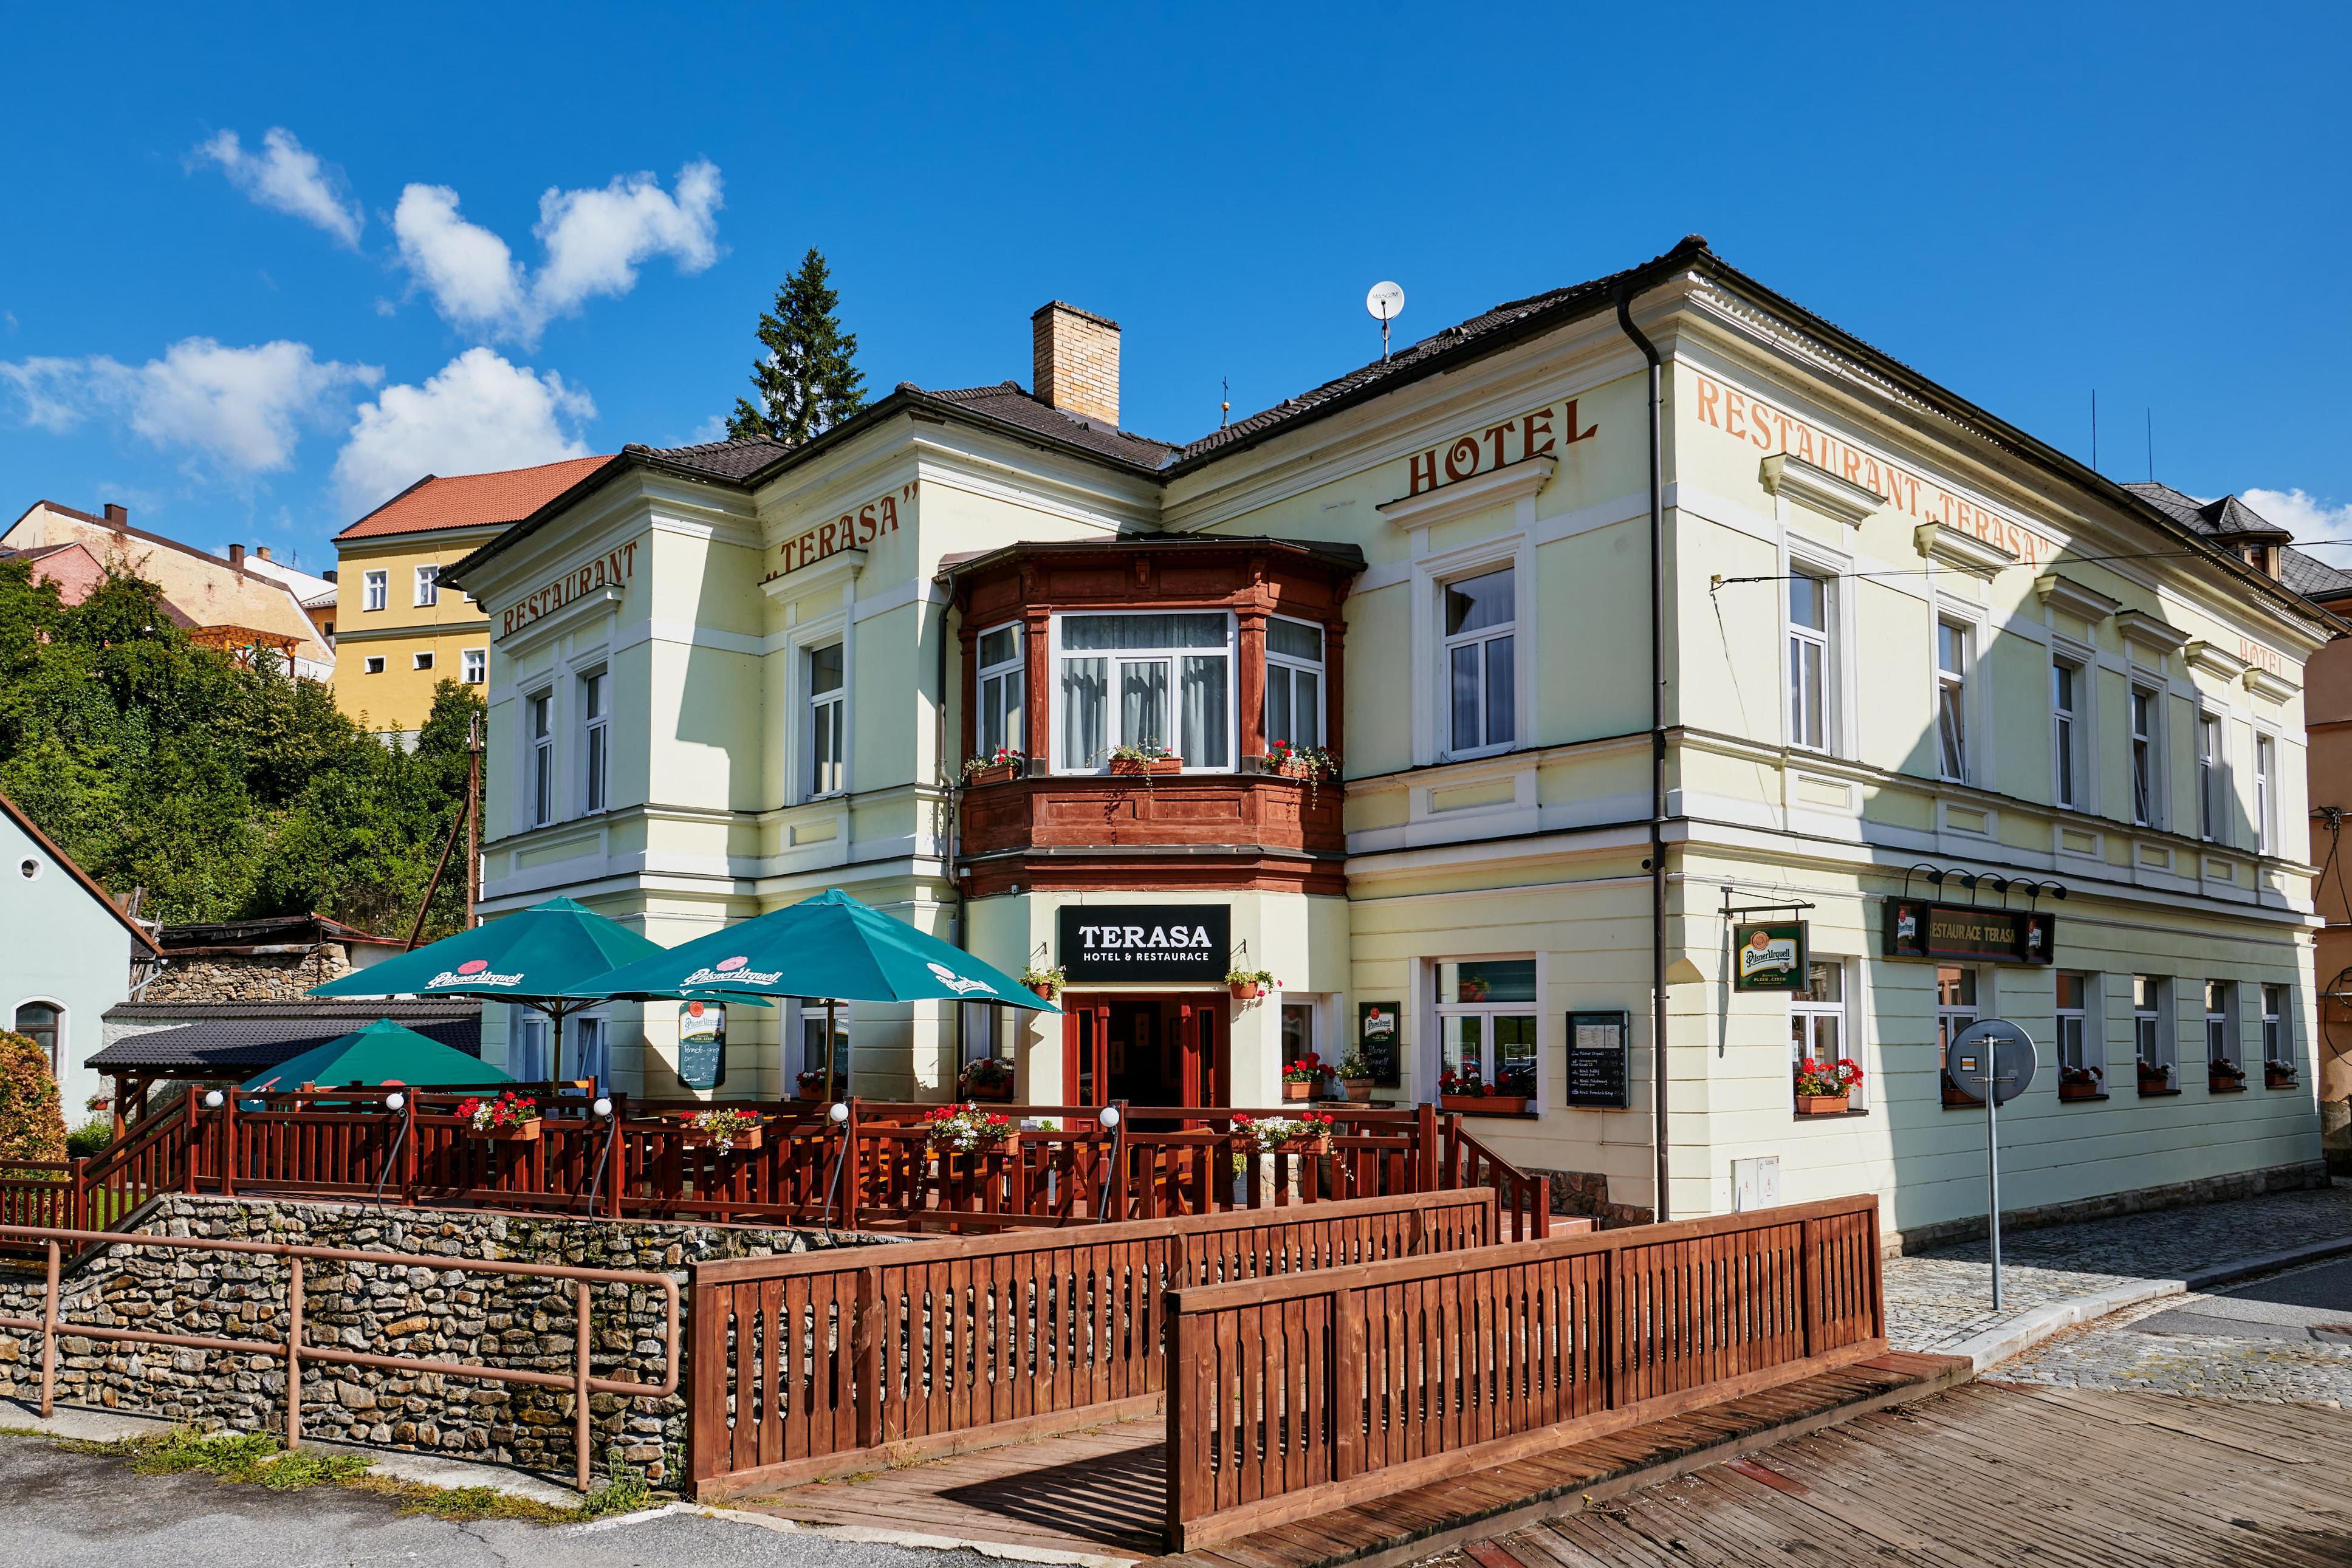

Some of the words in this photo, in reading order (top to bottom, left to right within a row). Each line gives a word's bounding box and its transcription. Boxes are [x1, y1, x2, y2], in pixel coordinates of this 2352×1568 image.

[1410, 399, 1599, 496] HOTEL
[1696, 376, 1922, 516] RESTAURANT
[504, 540, 637, 636] RESTAURANT
[1078, 925, 1212, 948] TERASA
[1984, 926, 2016, 943] TERASA
[1083, 952, 1121, 961] HOTEL
[1125, 953, 1131, 961] &
[1136, 952, 1209, 961] RESTAURACE
[1746, 951, 1769, 968] Pilsner
[425, 972, 482, 989] Pilsner
[679, 968, 737, 987] Pilsner
